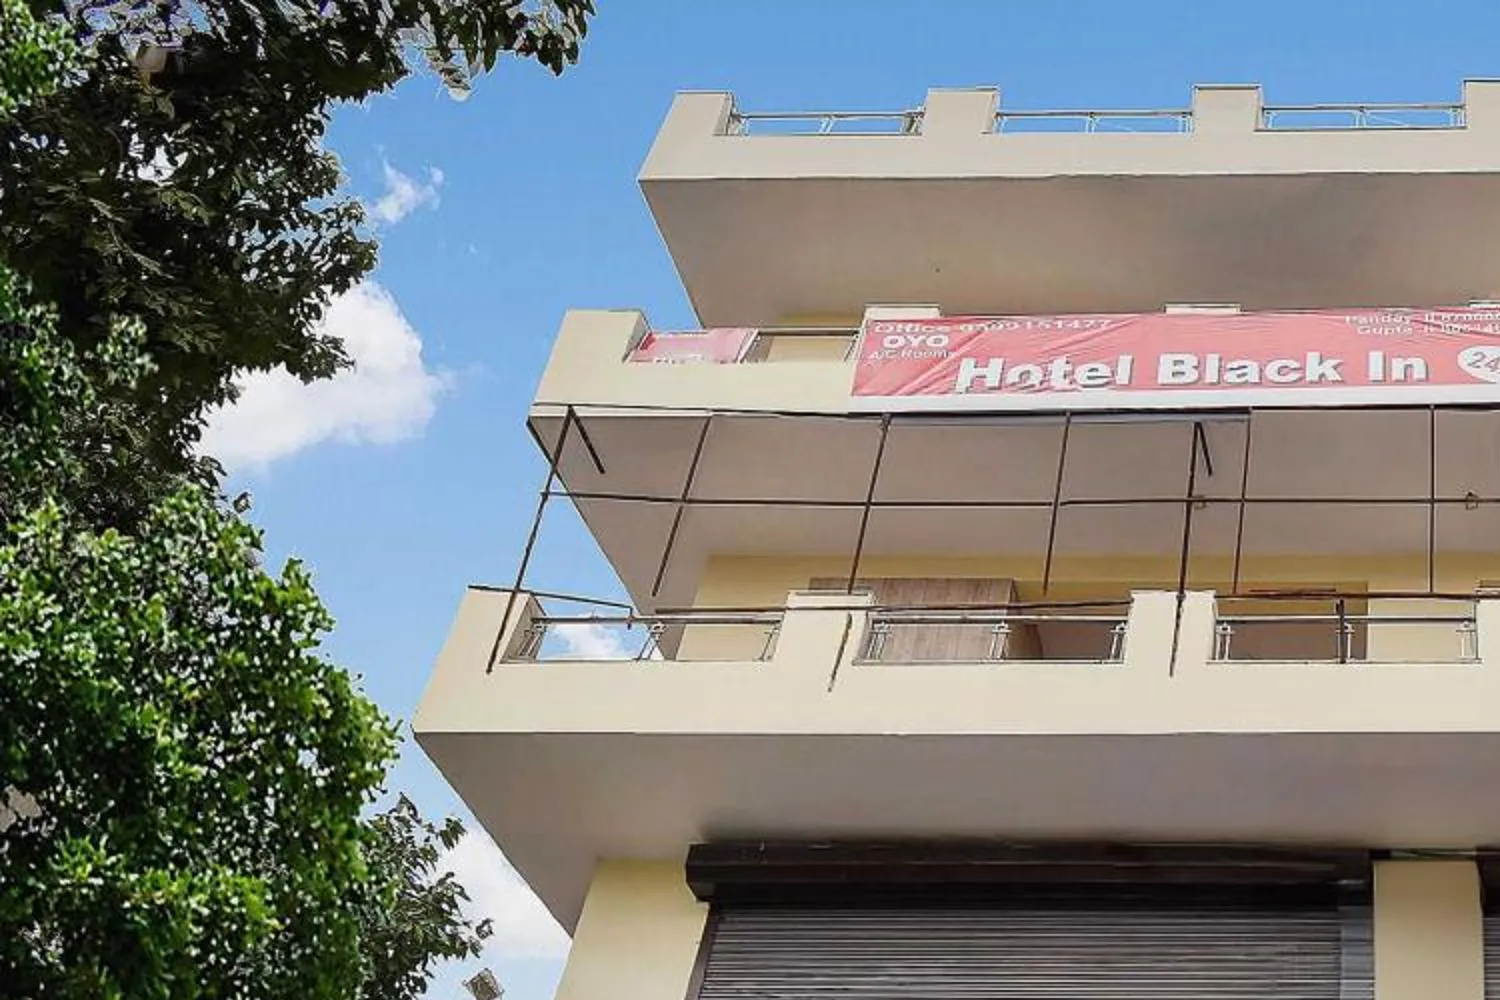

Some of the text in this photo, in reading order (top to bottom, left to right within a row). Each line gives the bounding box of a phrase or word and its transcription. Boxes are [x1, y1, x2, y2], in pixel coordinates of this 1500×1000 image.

[882, 335, 949, 349] OYO
[955, 350, 1429, 394] Hotel Black In
